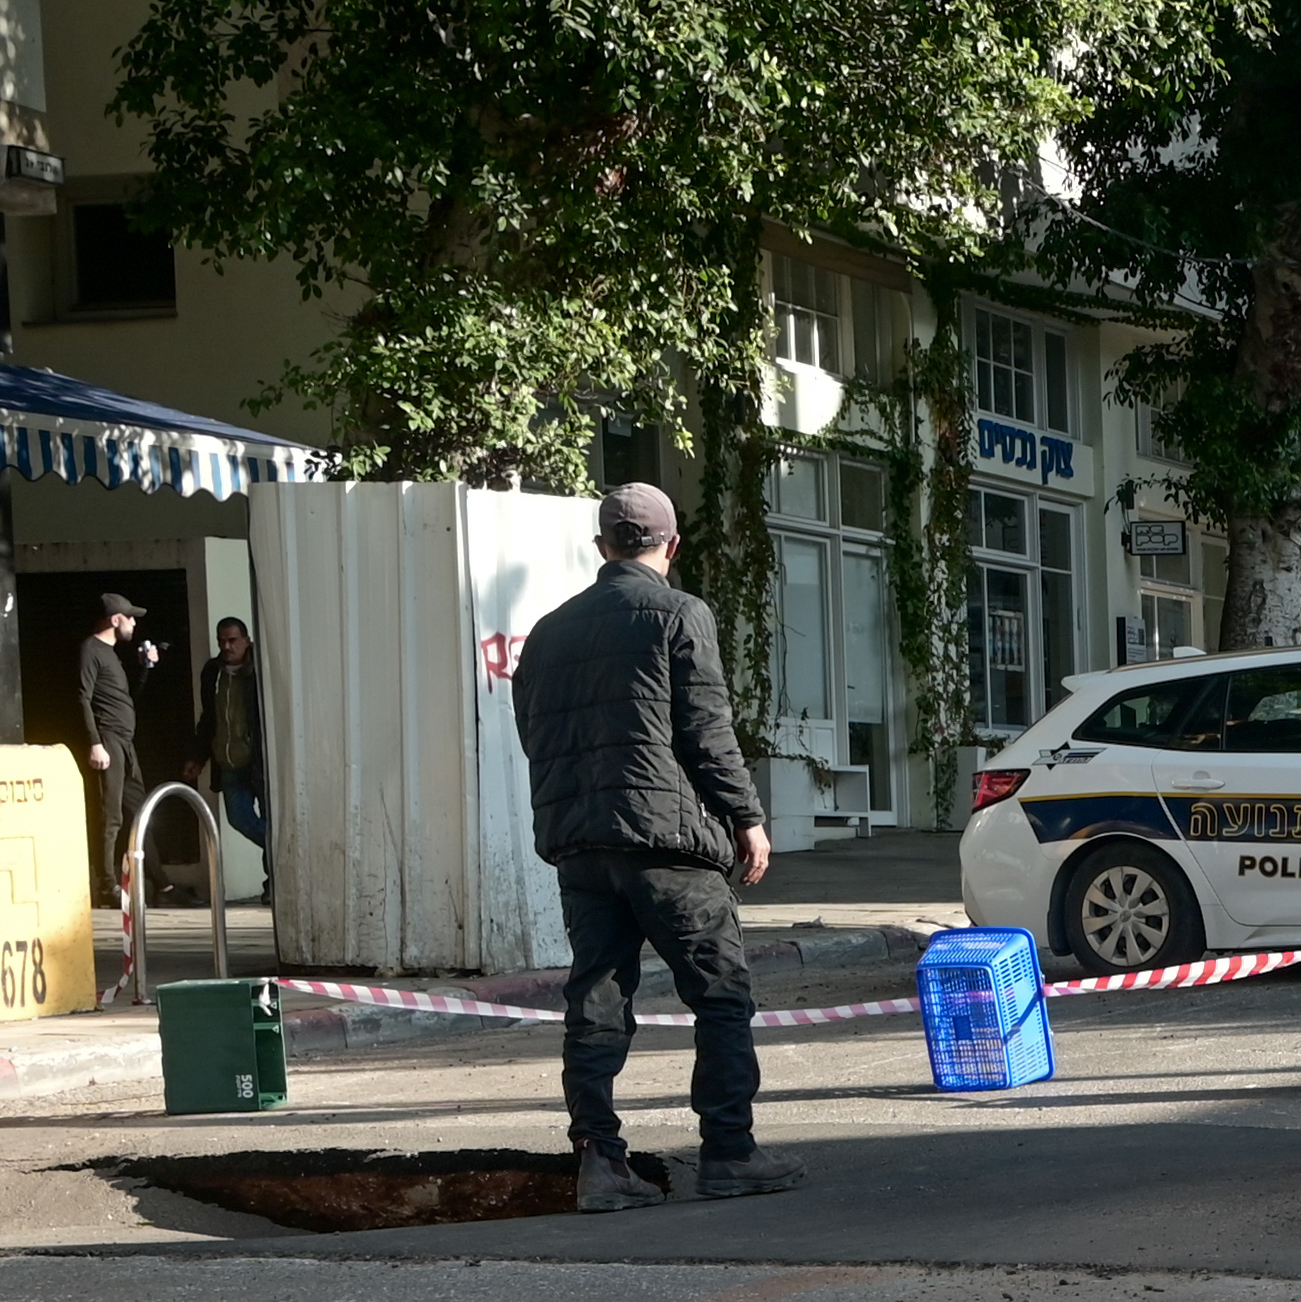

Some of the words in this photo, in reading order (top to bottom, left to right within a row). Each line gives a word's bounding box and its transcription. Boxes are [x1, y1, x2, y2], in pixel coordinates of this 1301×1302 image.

[977, 418, 1037, 472] נכסים
[1040, 435, 1074, 486] צוק
[1, 937, 47, 1008] 678
[241, 1074, 254, 1098] 500
